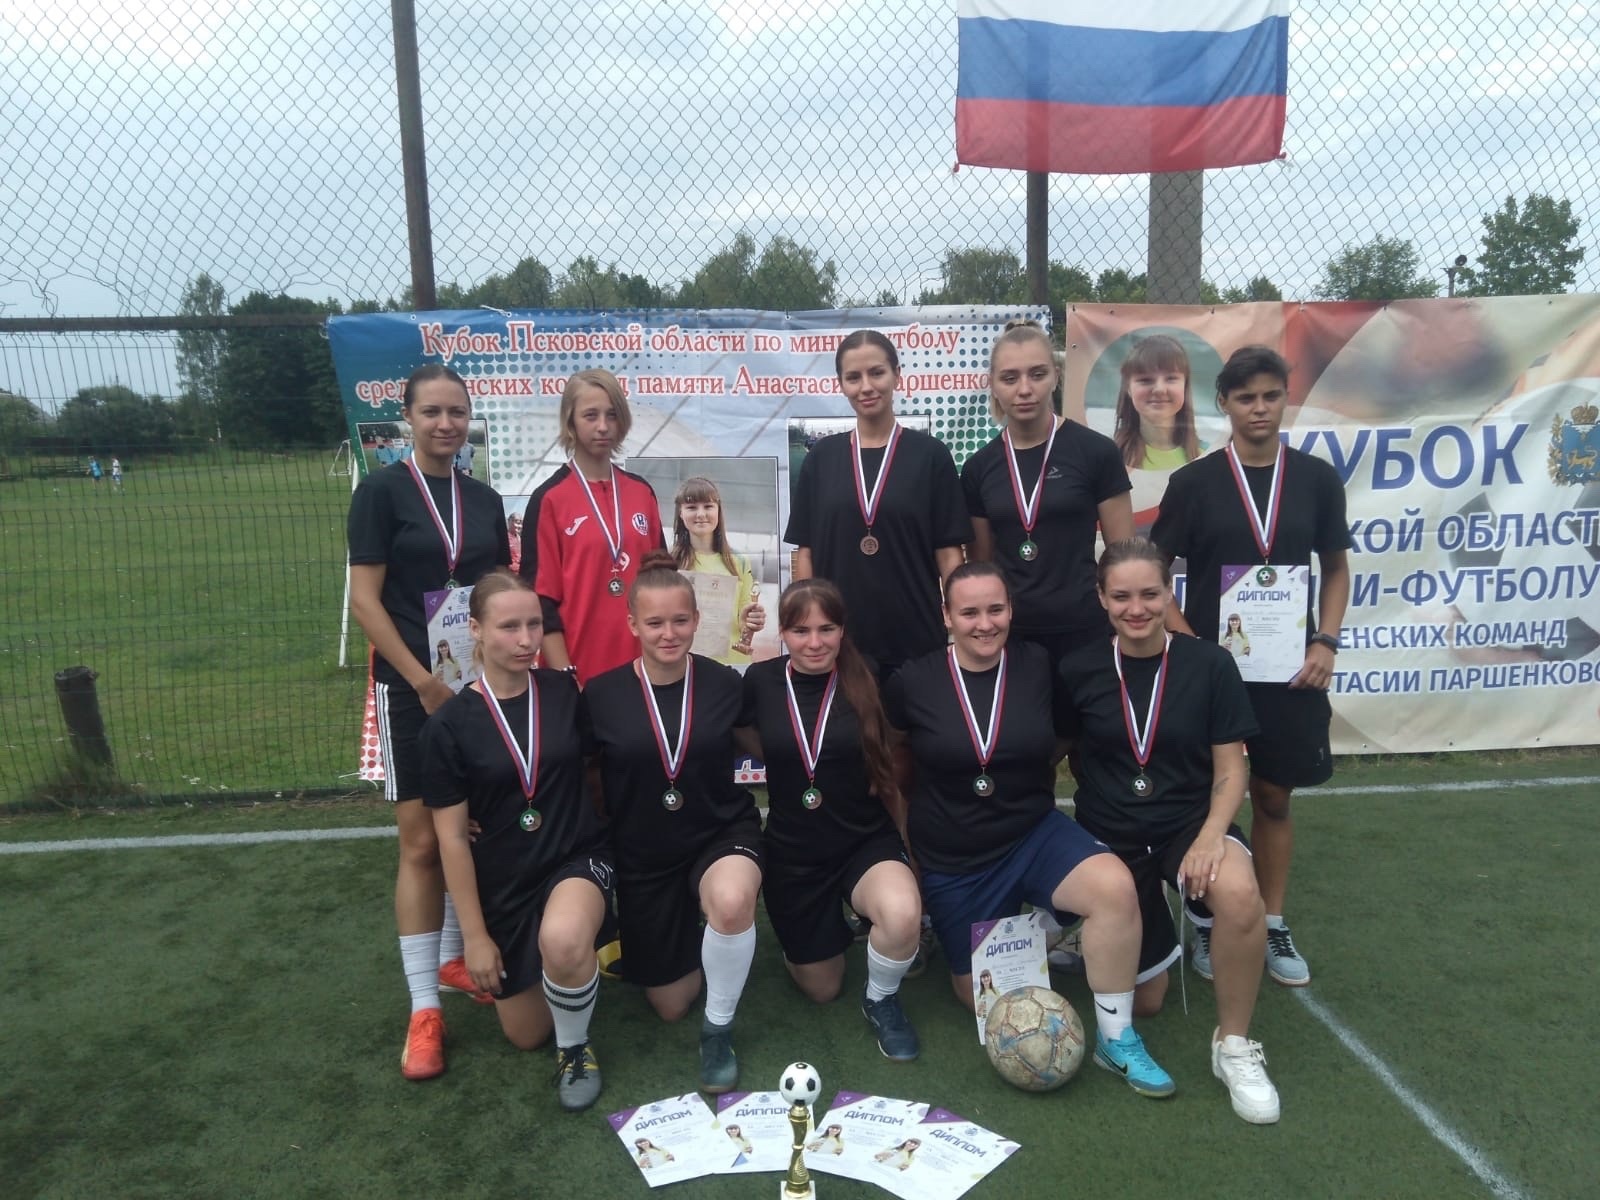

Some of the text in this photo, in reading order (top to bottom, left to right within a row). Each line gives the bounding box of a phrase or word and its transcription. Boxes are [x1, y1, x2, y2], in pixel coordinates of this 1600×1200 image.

[421, 324, 500, 359] Кубок
[509, 322, 642, 352] Псковской
[651, 326, 745, 351] области
[754, 332, 782, 352] по
[357, 381, 408, 406] сред
[638, 376, 724, 395] памяти
[732, 367, 843, 395] Анастаси
[893, 373, 990, 398] аршенко
[1437, 511, 1600, 552] ОБЛАСТ
[1236, 590, 1291, 603] ДИПЛОМ
[1312, 564, 1600, 607] И-ФУТБОЛУ
[1338, 619, 1566, 649] ЕНСКИХ КОМАНД
[1326, 670, 1422, 693] ТАСИИ
[986, 938, 1033, 958] ДИПЛОМ
[635, 1109, 693, 1131] ДИПЛОМ
[844, 1110, 905, 1126] ДИПЛОМ
[929, 1128, 987, 1158] ДИПЛОМ
